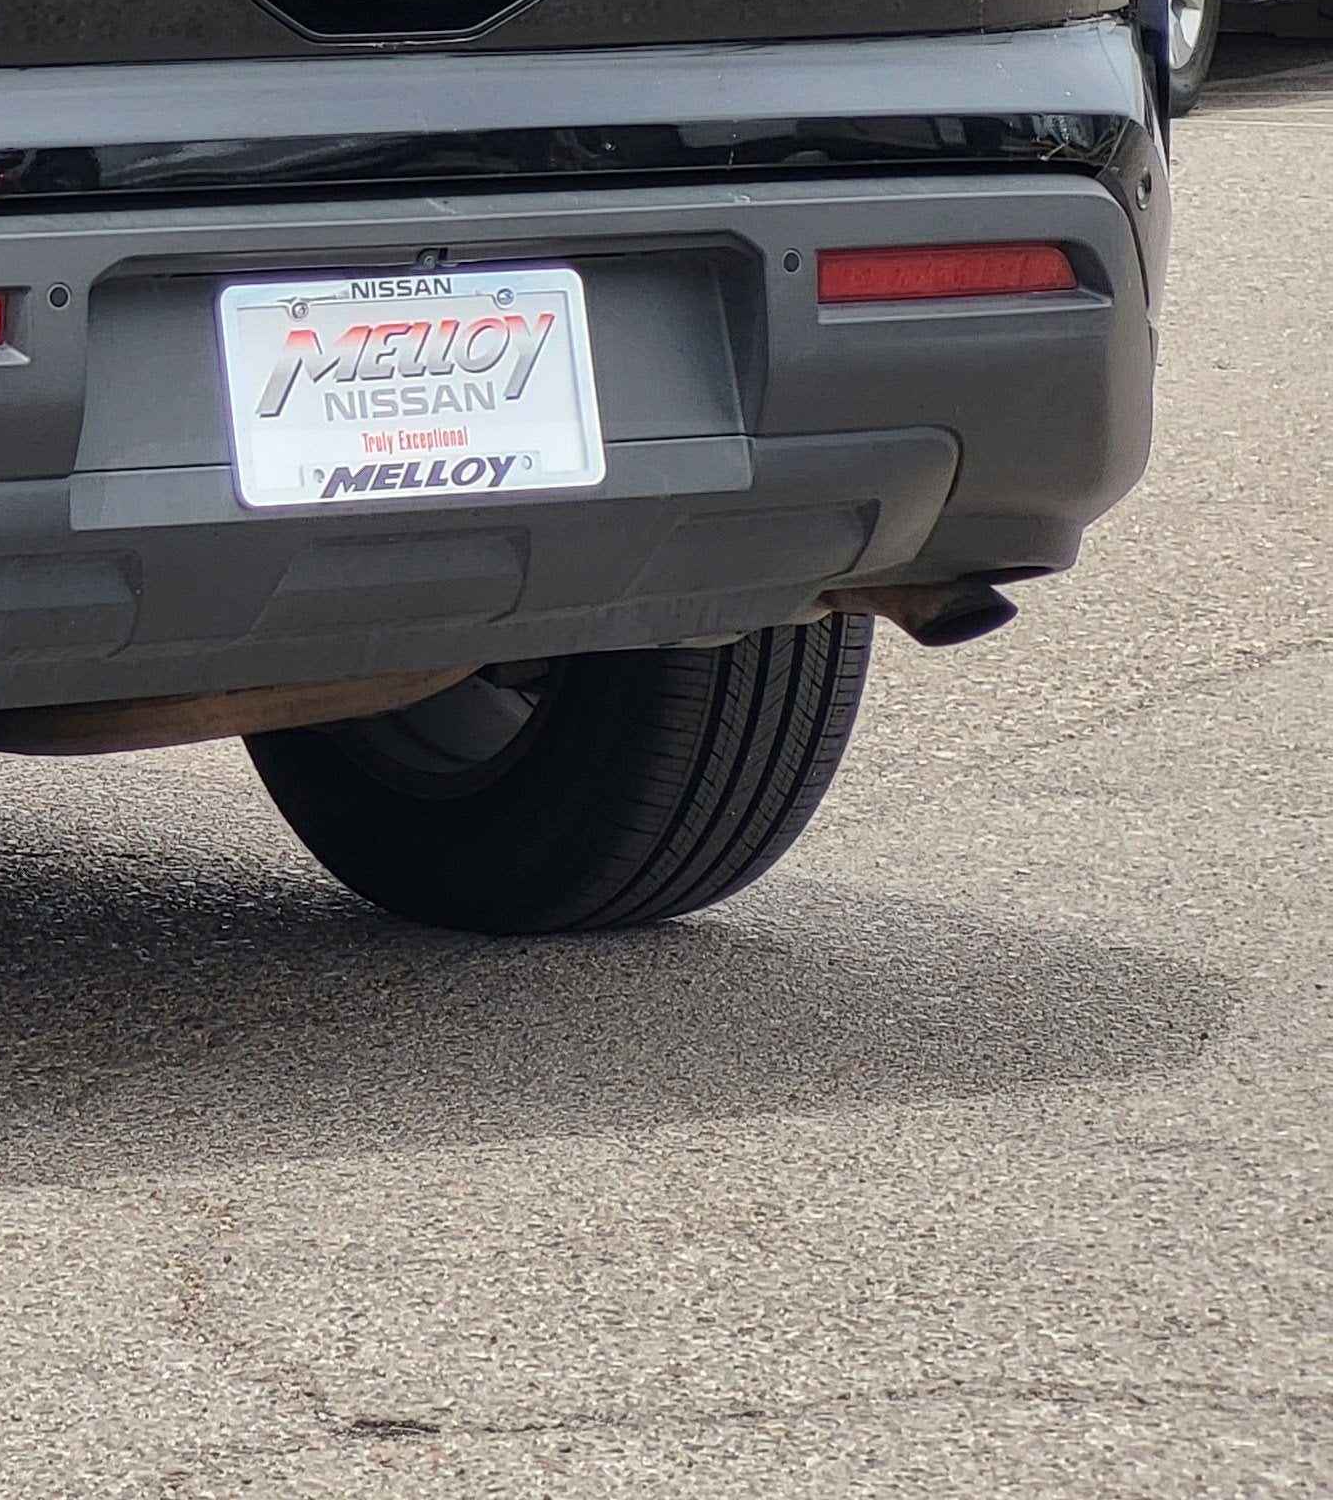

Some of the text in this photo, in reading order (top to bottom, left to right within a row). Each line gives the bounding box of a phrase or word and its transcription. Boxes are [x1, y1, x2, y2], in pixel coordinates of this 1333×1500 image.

[351, 277, 453, 300] NISSAN
[256, 313, 555, 419] MELLOY
[324, 381, 496, 422] NISSAN
[361, 426, 469, 455] Truly Exceptional
[320, 455, 518, 500] MELLOY
